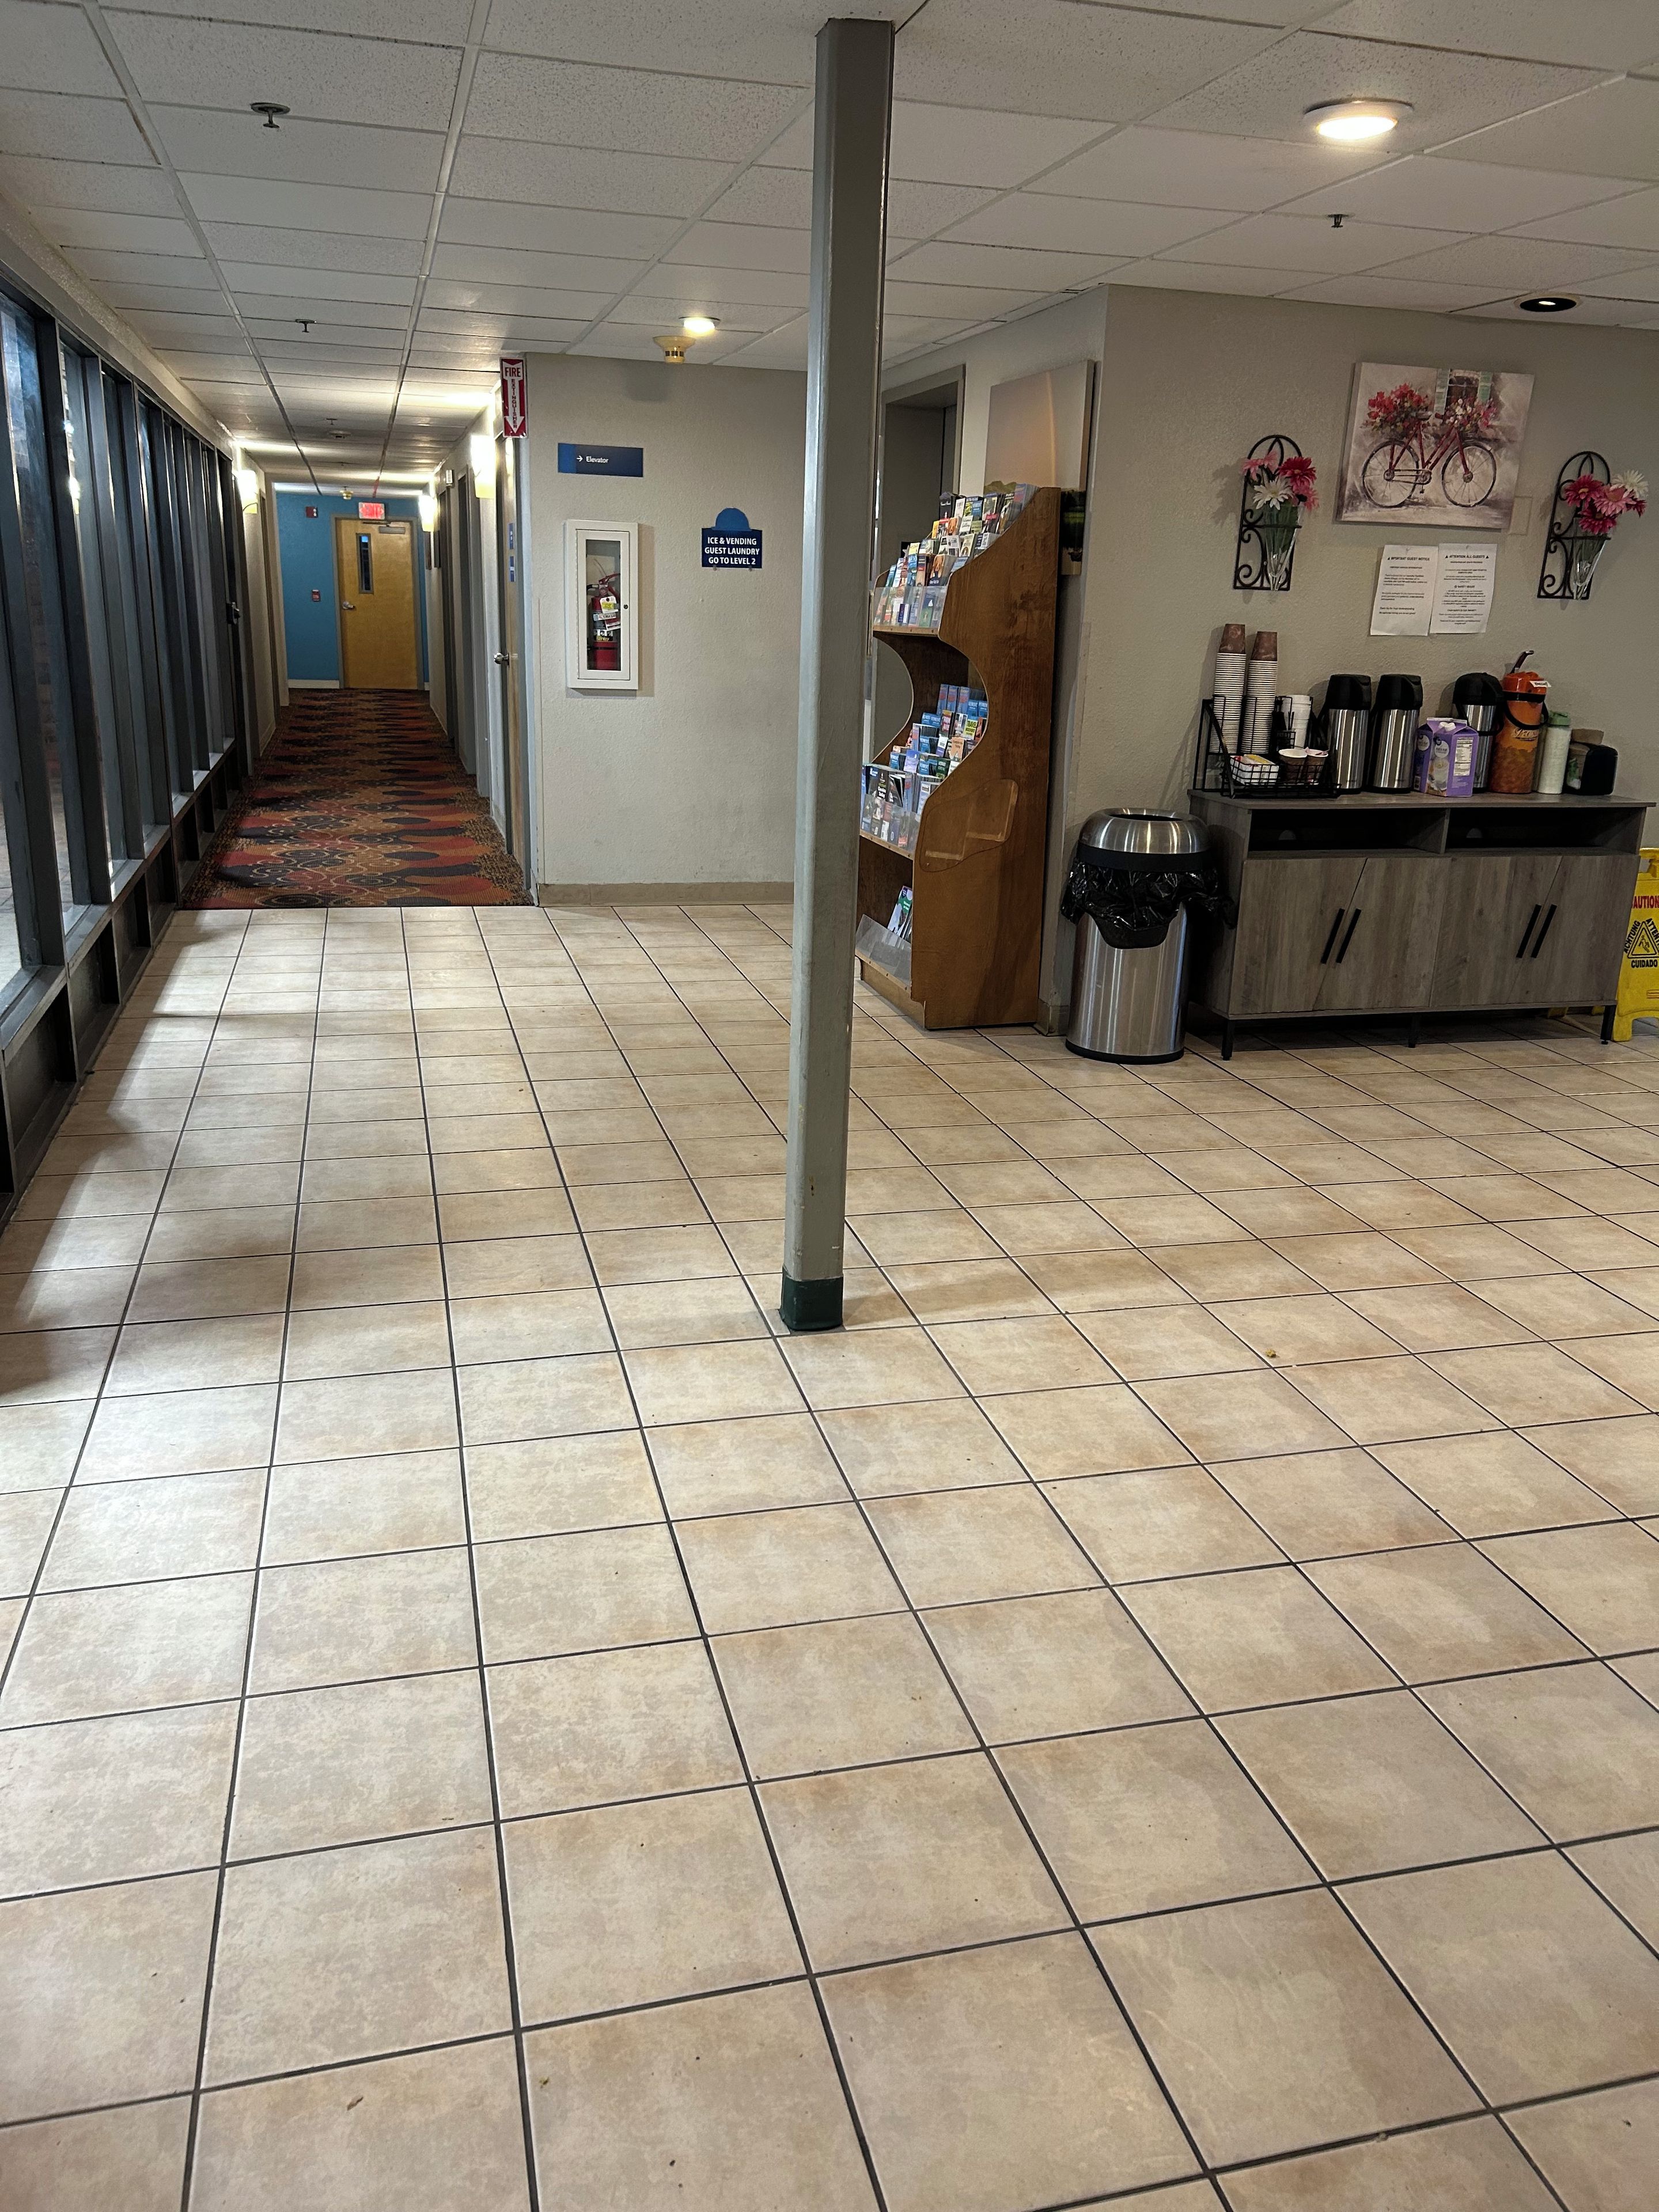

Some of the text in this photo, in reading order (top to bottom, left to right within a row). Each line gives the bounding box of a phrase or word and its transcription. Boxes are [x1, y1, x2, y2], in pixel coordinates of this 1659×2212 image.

[505, 367, 521, 377] FIRE
[726, 537, 757, 546] VENDING
[1633, 895, 1659, 909] AUTION
[1623, 920, 1641, 954] ACHTUNG
[1631, 959, 1658, 968] CUIDADO
